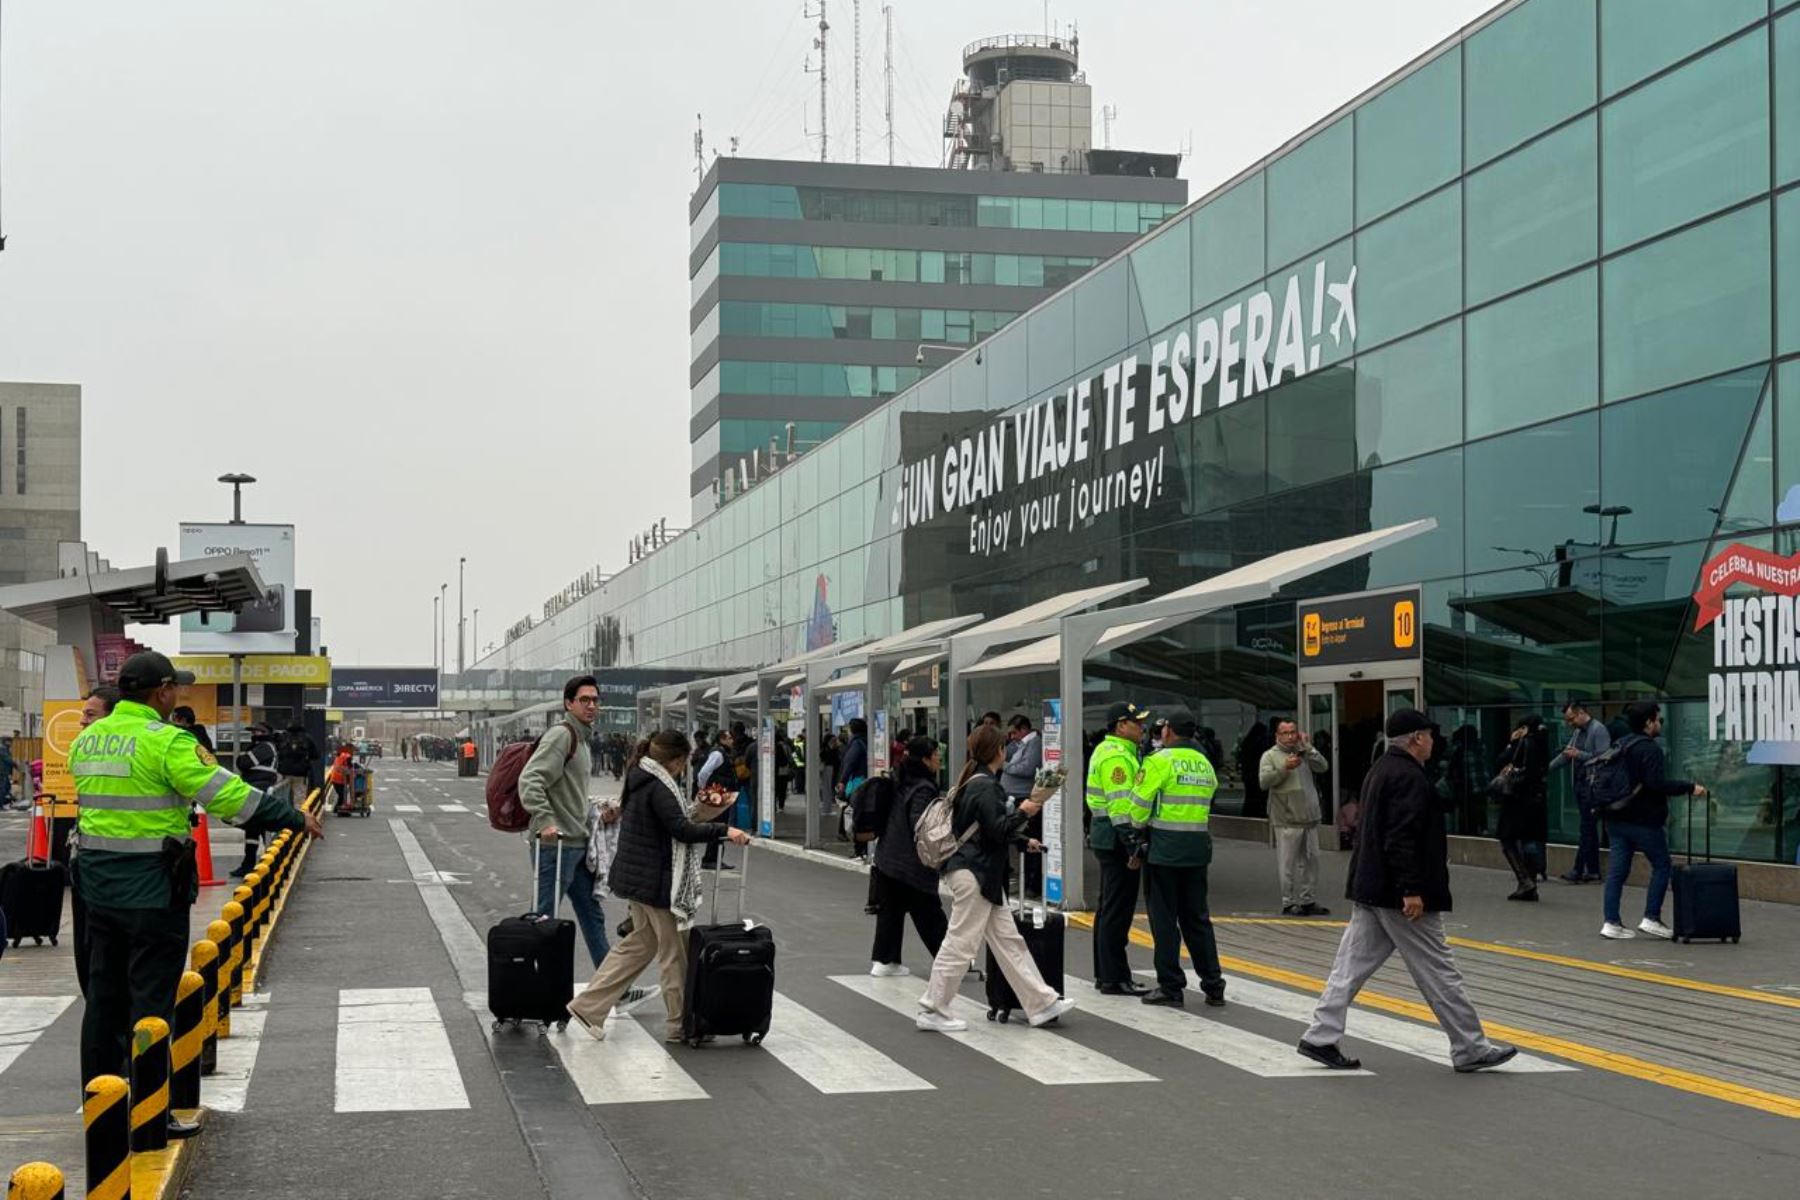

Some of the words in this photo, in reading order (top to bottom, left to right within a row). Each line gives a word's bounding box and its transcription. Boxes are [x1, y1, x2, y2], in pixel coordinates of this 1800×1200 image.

[941, 420, 1006, 512] GRAN
[1015, 378, 1091, 485] VIAJE
[1103, 355, 1137, 450] TE
[1148, 260, 1326, 434] ESPERA!
[969, 509, 1012, 556] Enjoy
[1020, 492, 1060, 547] your
[1069, 446, 1163, 532] journey!
[204, 546, 231, 556] OPPO
[1710, 555, 1754, 586] CELEBRA
[1398, 612, 1410, 637] 10
[240, 664, 265, 678] DE
[269, 664, 318, 678] PAGO
[393, 684, 436, 693] DIRECTV
[76, 734, 137, 757] POLICIA
